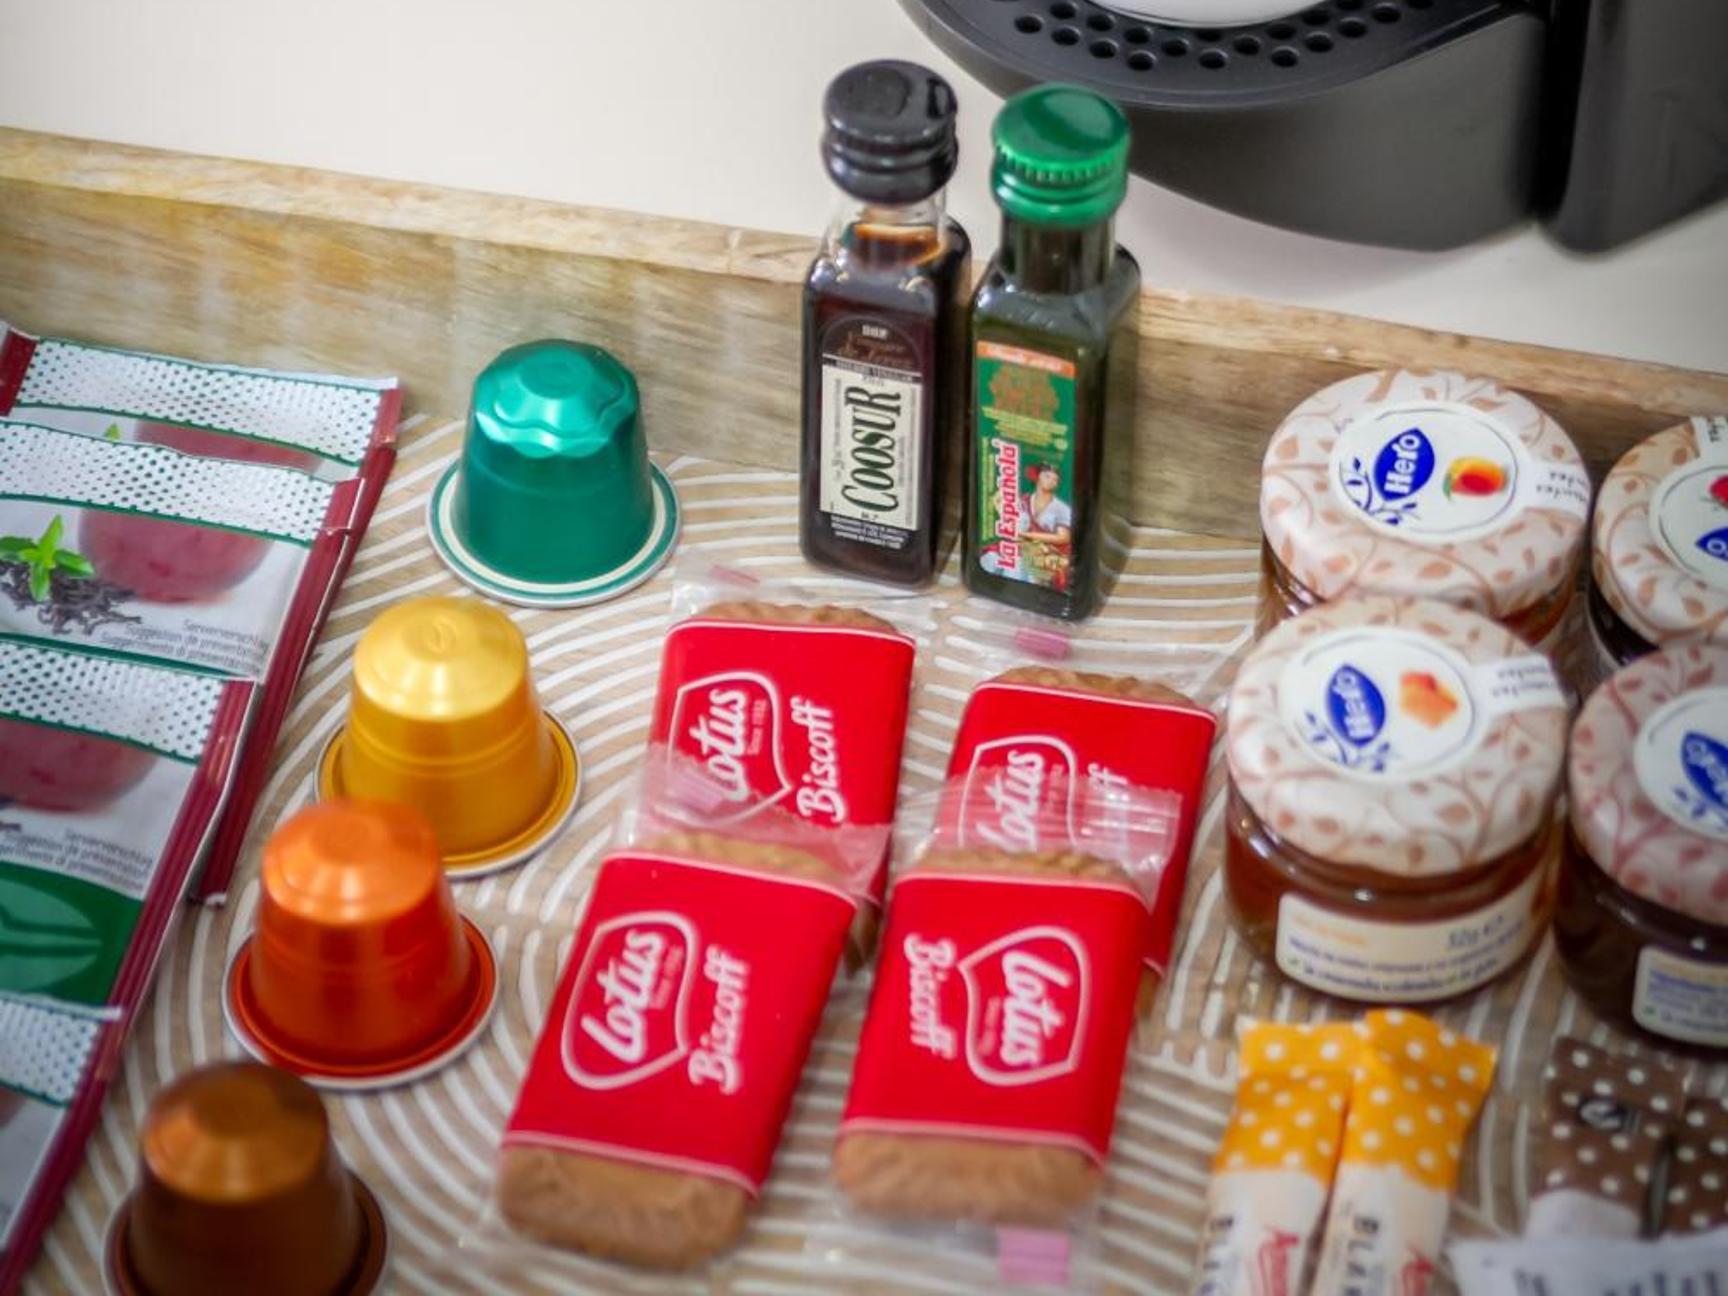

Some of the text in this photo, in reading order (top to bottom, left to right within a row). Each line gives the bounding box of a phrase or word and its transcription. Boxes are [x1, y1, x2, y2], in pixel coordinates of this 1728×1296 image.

[994, 442, 1019, 570] La Española
[1383, 432, 1422, 495] Hero
[789, 694, 847, 824] Biscoff
[1335, 671, 1374, 741] Hero
[580, 927, 665, 1064] Lotus
[688, 943, 750, 1097] Biscoff
[903, 932, 957, 1060] Biscoff
[1000, 949, 1073, 1067] Lotus
